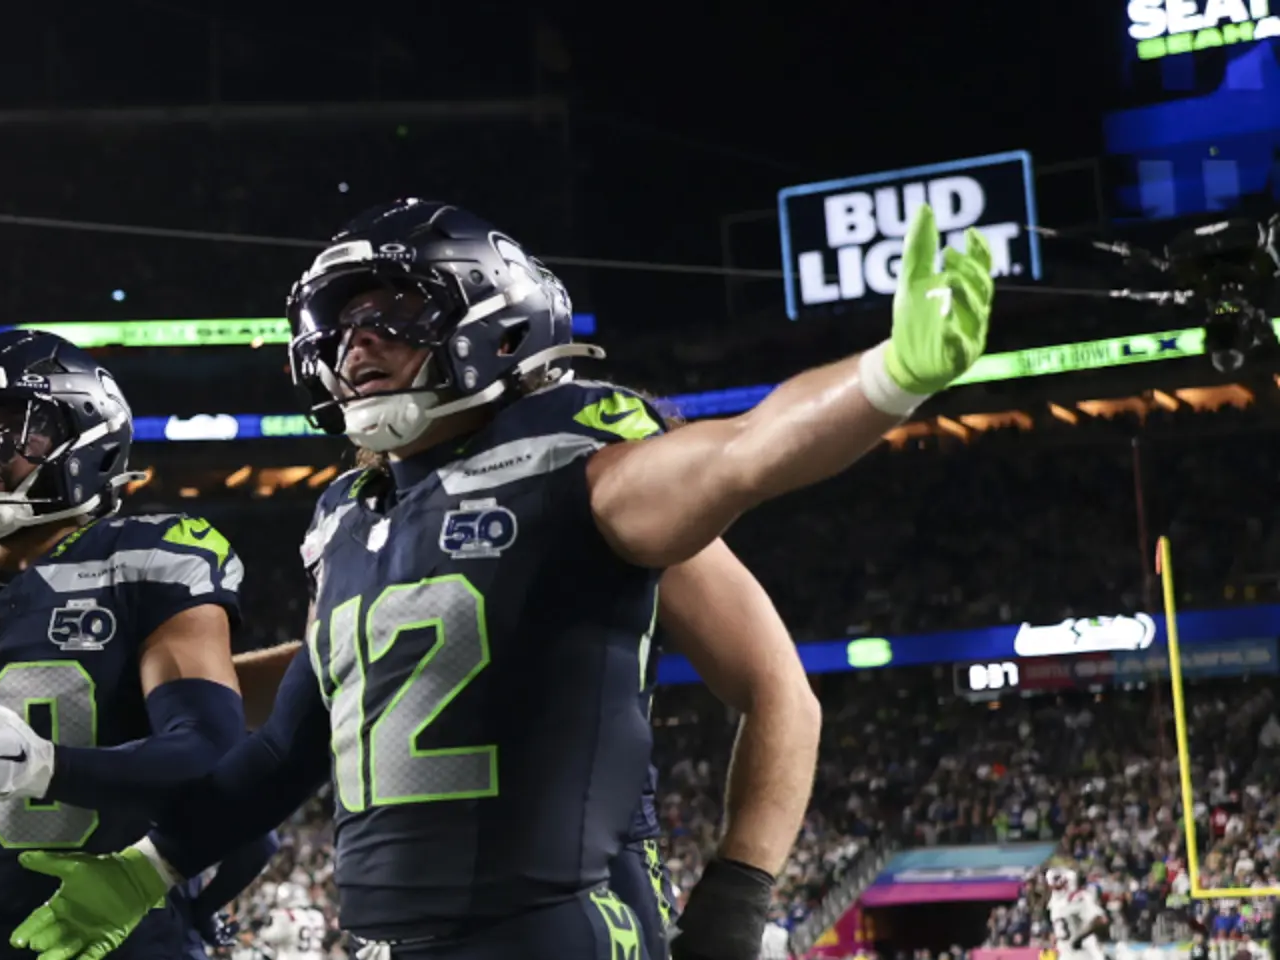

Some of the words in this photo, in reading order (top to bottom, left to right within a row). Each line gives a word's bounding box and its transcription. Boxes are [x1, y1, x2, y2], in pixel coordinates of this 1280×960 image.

[824, 176, 985, 249] BUD
[798, 223, 1020, 305] LIGT
[444, 511, 516, 552] 50
[50, 609, 115, 643] 50
